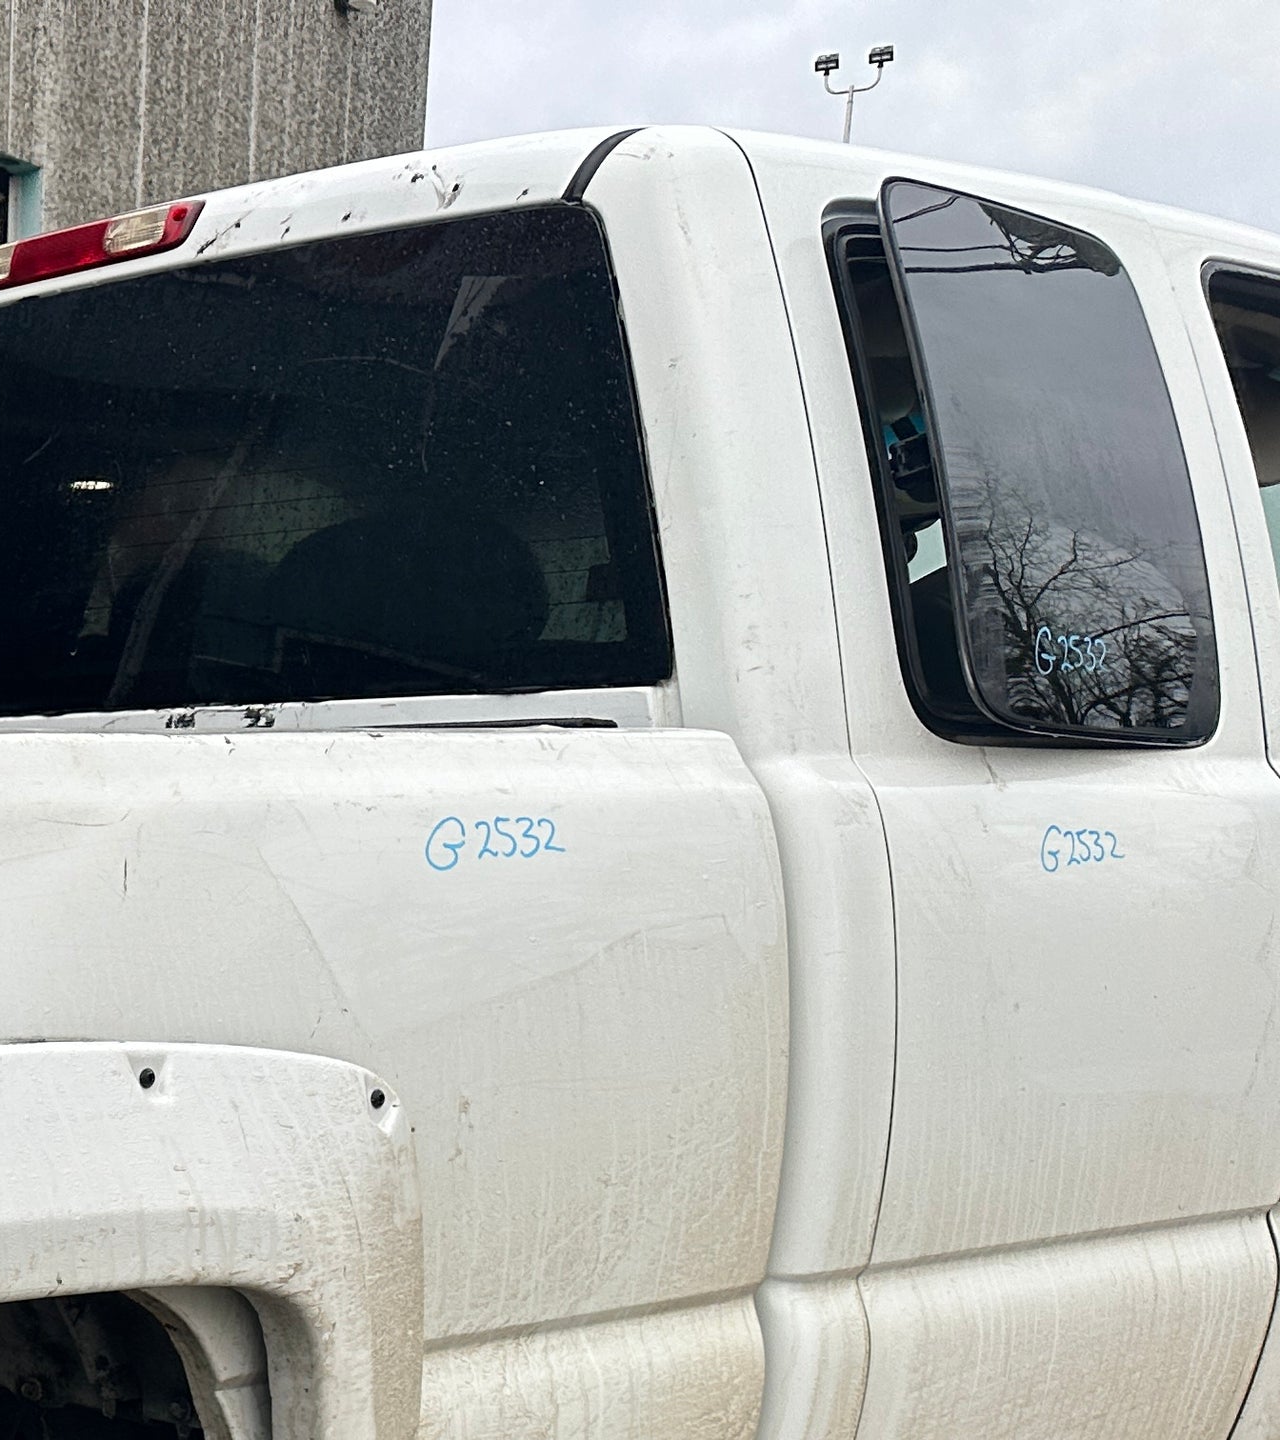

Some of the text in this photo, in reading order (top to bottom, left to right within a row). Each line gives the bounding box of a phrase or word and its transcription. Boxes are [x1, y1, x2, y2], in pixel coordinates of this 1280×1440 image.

[1035, 625, 1109, 676] G2532
[425, 816, 567, 872] G2532
[1041, 824, 1126, 873] G2532
